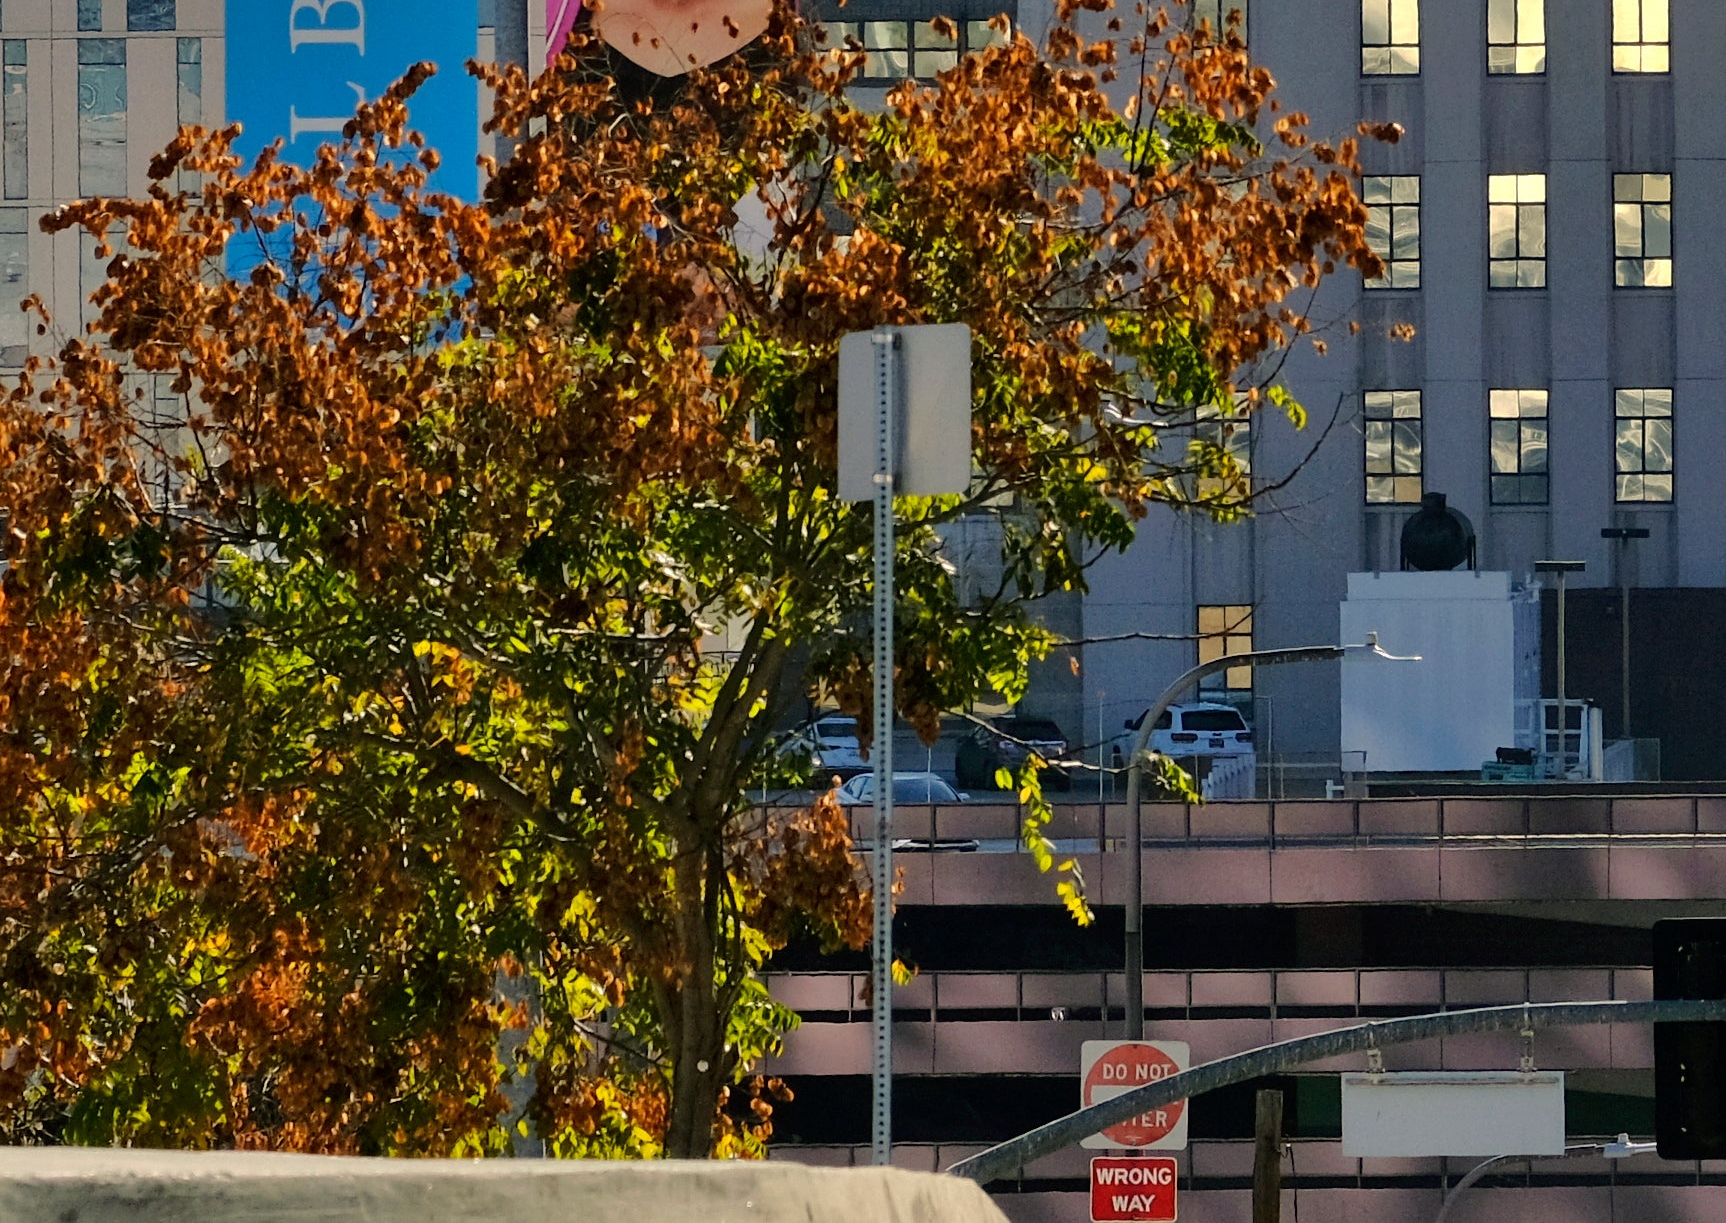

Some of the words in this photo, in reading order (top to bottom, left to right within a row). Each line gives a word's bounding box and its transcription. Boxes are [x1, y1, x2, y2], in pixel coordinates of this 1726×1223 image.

[1102, 1063, 1128, 1080] DO
[1135, 1063, 1172, 1080] NOT
[1095, 1167, 1173, 1186] WRONG
[1111, 1194, 1156, 1213] WAY
